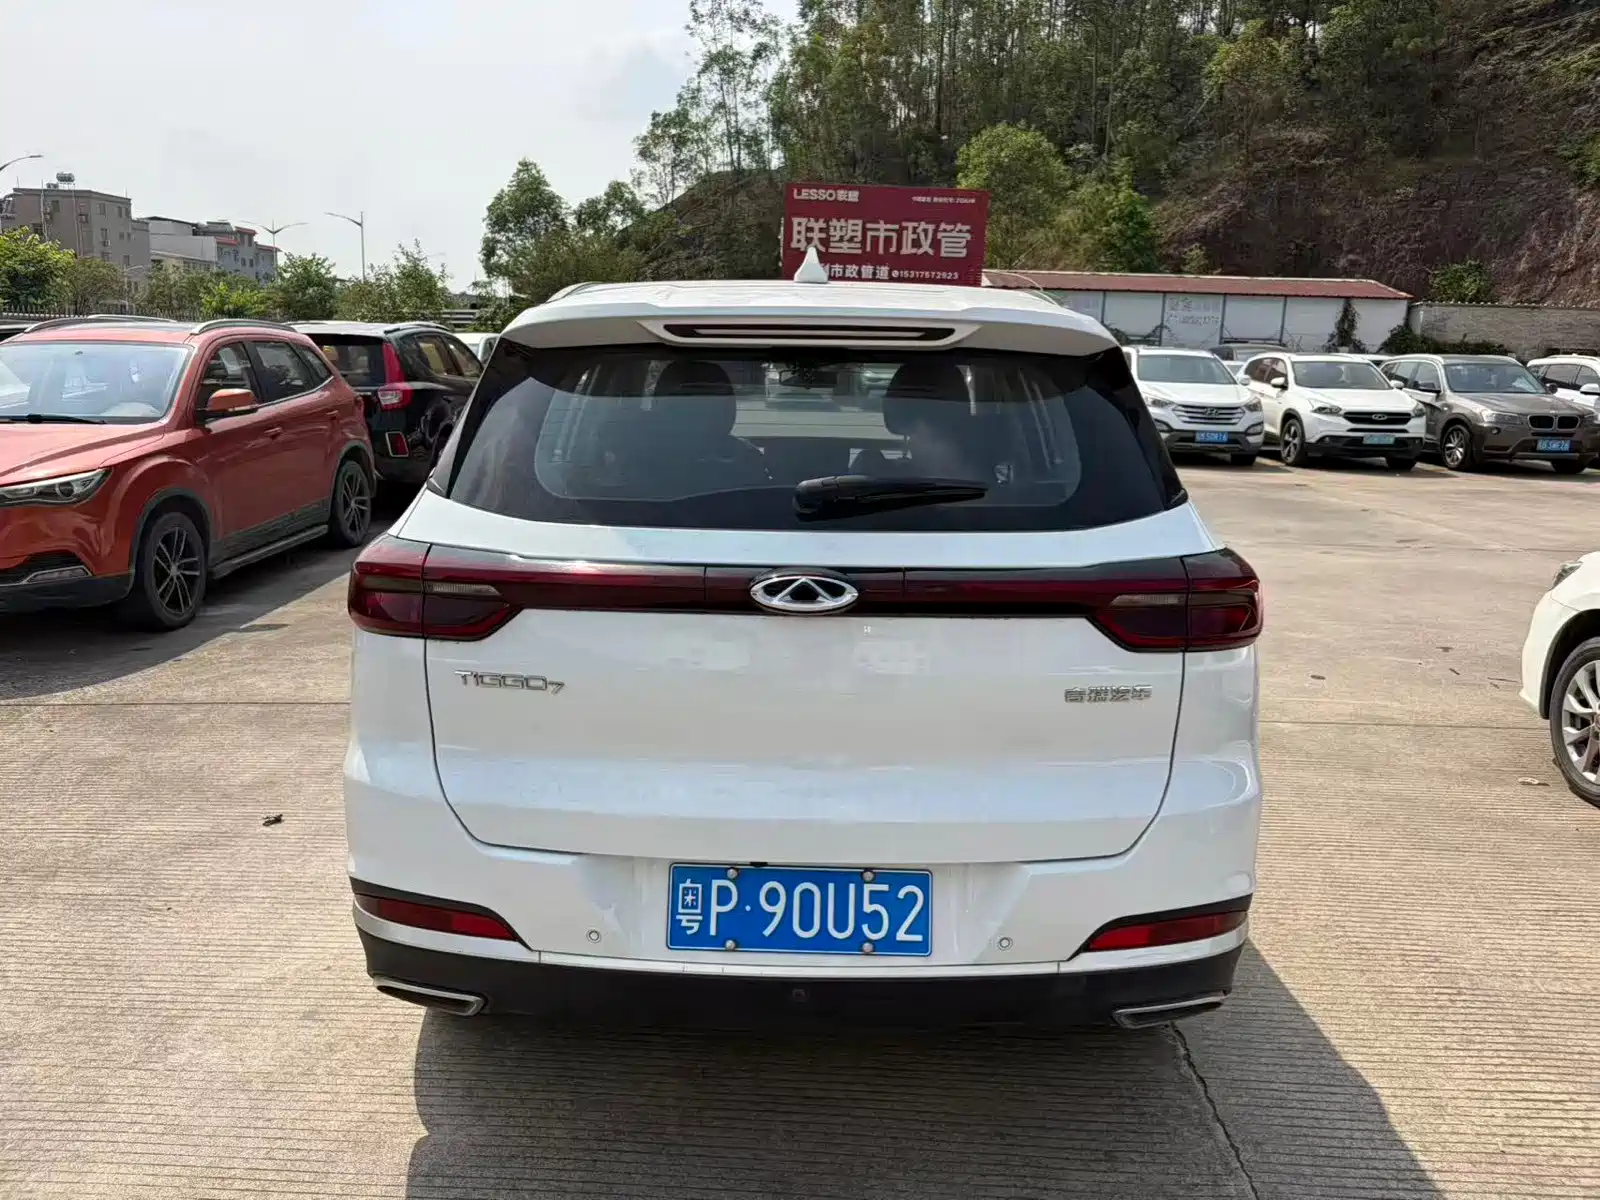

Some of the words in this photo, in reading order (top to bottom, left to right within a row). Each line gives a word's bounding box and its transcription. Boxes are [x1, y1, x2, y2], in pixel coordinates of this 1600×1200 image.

[793, 188, 836, 201] LESSO
[791, 217, 972, 258] 联塑市政管
